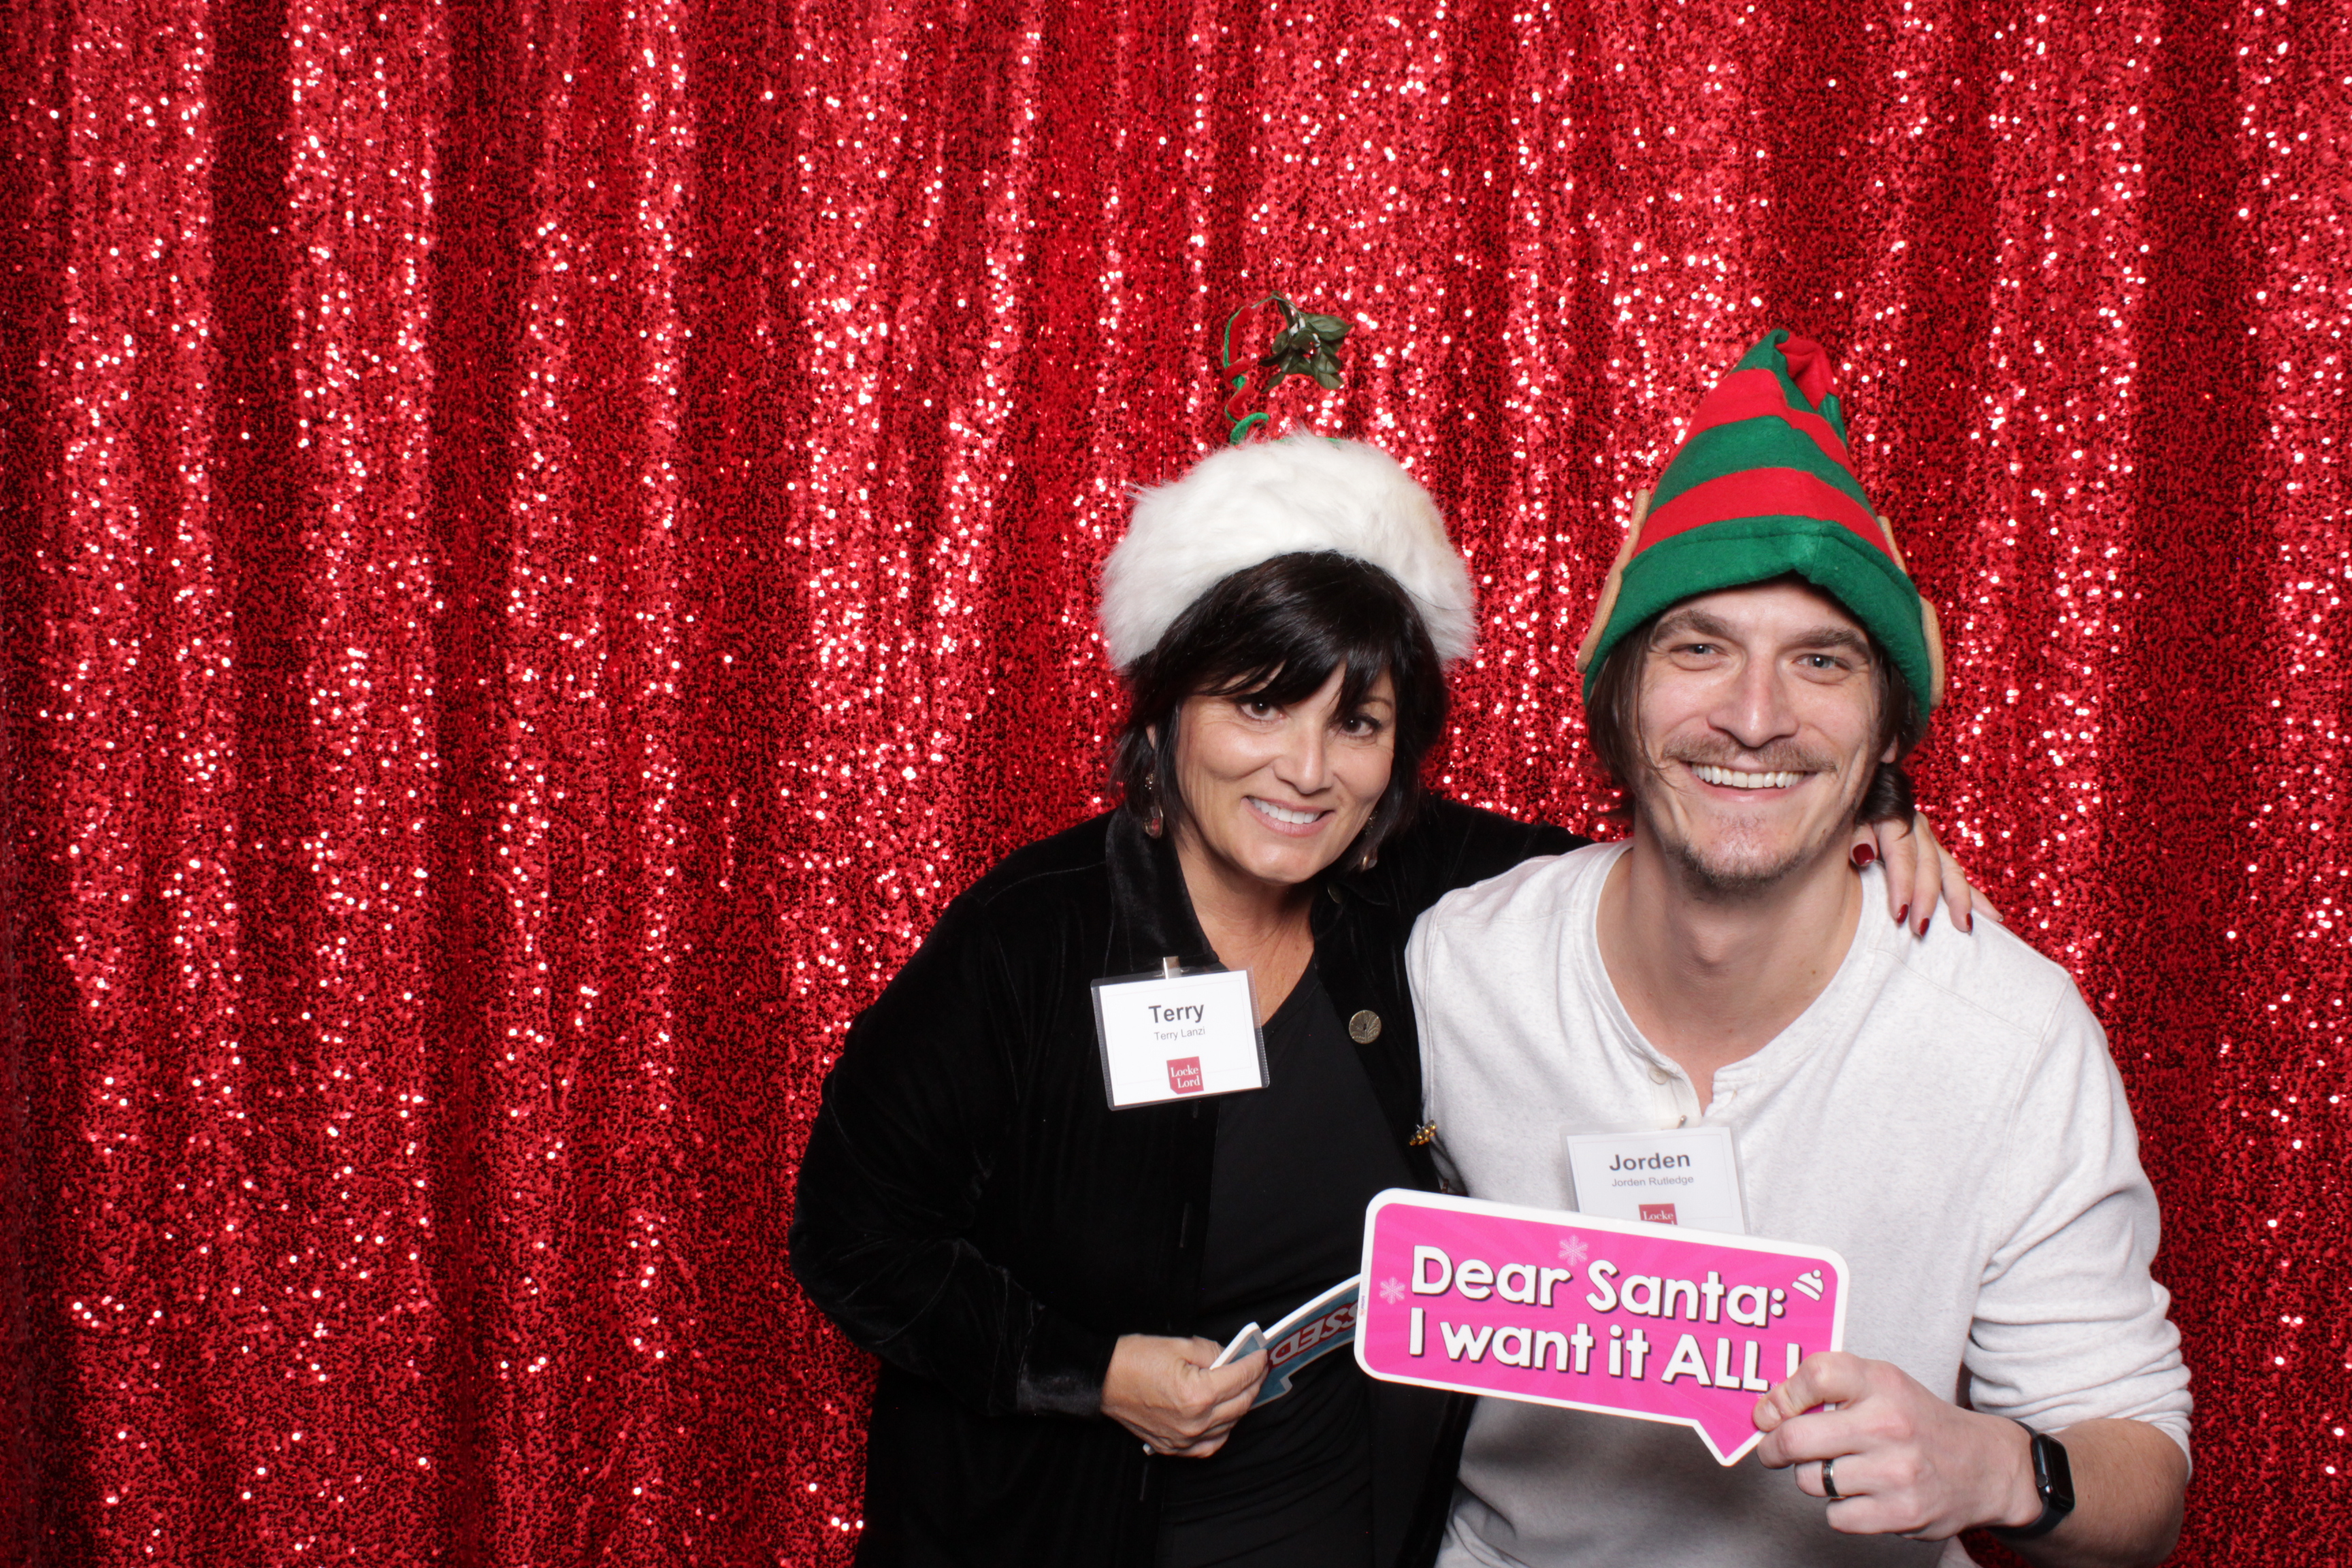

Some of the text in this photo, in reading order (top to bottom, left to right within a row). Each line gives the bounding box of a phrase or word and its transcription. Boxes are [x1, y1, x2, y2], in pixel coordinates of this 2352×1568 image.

[1148, 1004, 1204, 1024] Terry
[1154, 1026, 1206, 1041] Terry Lanzi
[1171, 1065, 1199, 1078] Locke
[1177, 1076, 1200, 1088] Lord
[1609, 1153, 1691, 1171] Jorden
[1612, 1175, 1694, 1187] Jorden Rutledge
[1643, 1211, 1674, 1221] Locke
[1411, 1245, 1573, 1307] Dear
[1586, 1259, 1786, 1328] Santa:
[1409, 1307, 1426, 1357] I
[1439, 1322, 1595, 1375] want
[1608, 1324, 1651, 1381] it
[1661, 1333, 1769, 1393] ALL
